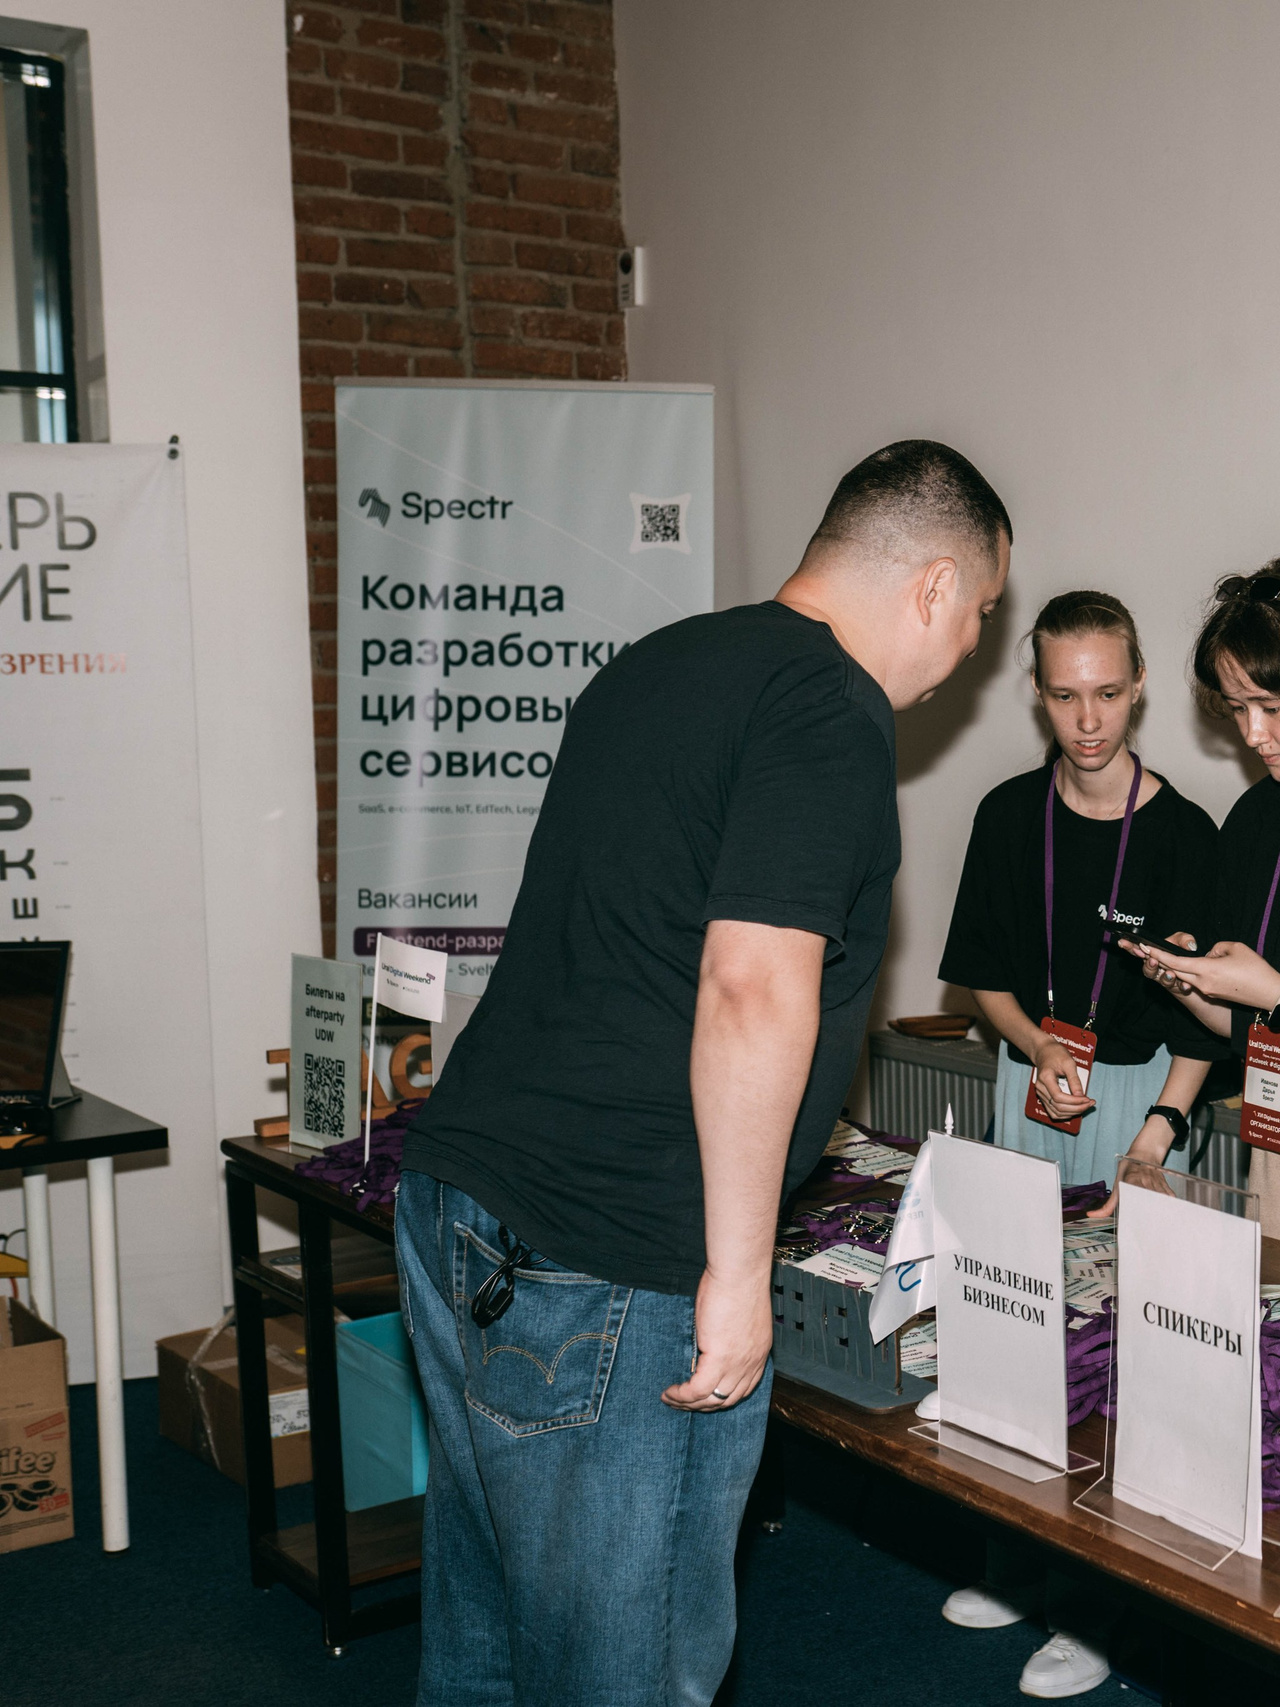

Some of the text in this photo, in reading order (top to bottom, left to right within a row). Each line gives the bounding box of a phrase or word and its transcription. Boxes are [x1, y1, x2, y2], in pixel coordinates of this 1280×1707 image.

[401, 491, 513, 525] Spectr
[361, 575, 564, 617] Команда
[361, 687, 571, 733] цифровы
[359, 748, 553, 788] сервисо
[357, 888, 478, 909] Вакансии
[305, 983, 345, 1002] Билеты на
[305, 1006, 345, 1026] afterparty
[315, 1028, 335, 1042] UDW
[1248, 1039, 1260, 1049] Ural
[1259, 1041, 1273, 1053] Digital
[953, 1254, 1054, 1300] УПРАВЛЕНИЕ
[963, 1285, 1045, 1327] БИЗНЕСОМ
[1143, 1301, 1243, 1356] СПИКЕРЫ
